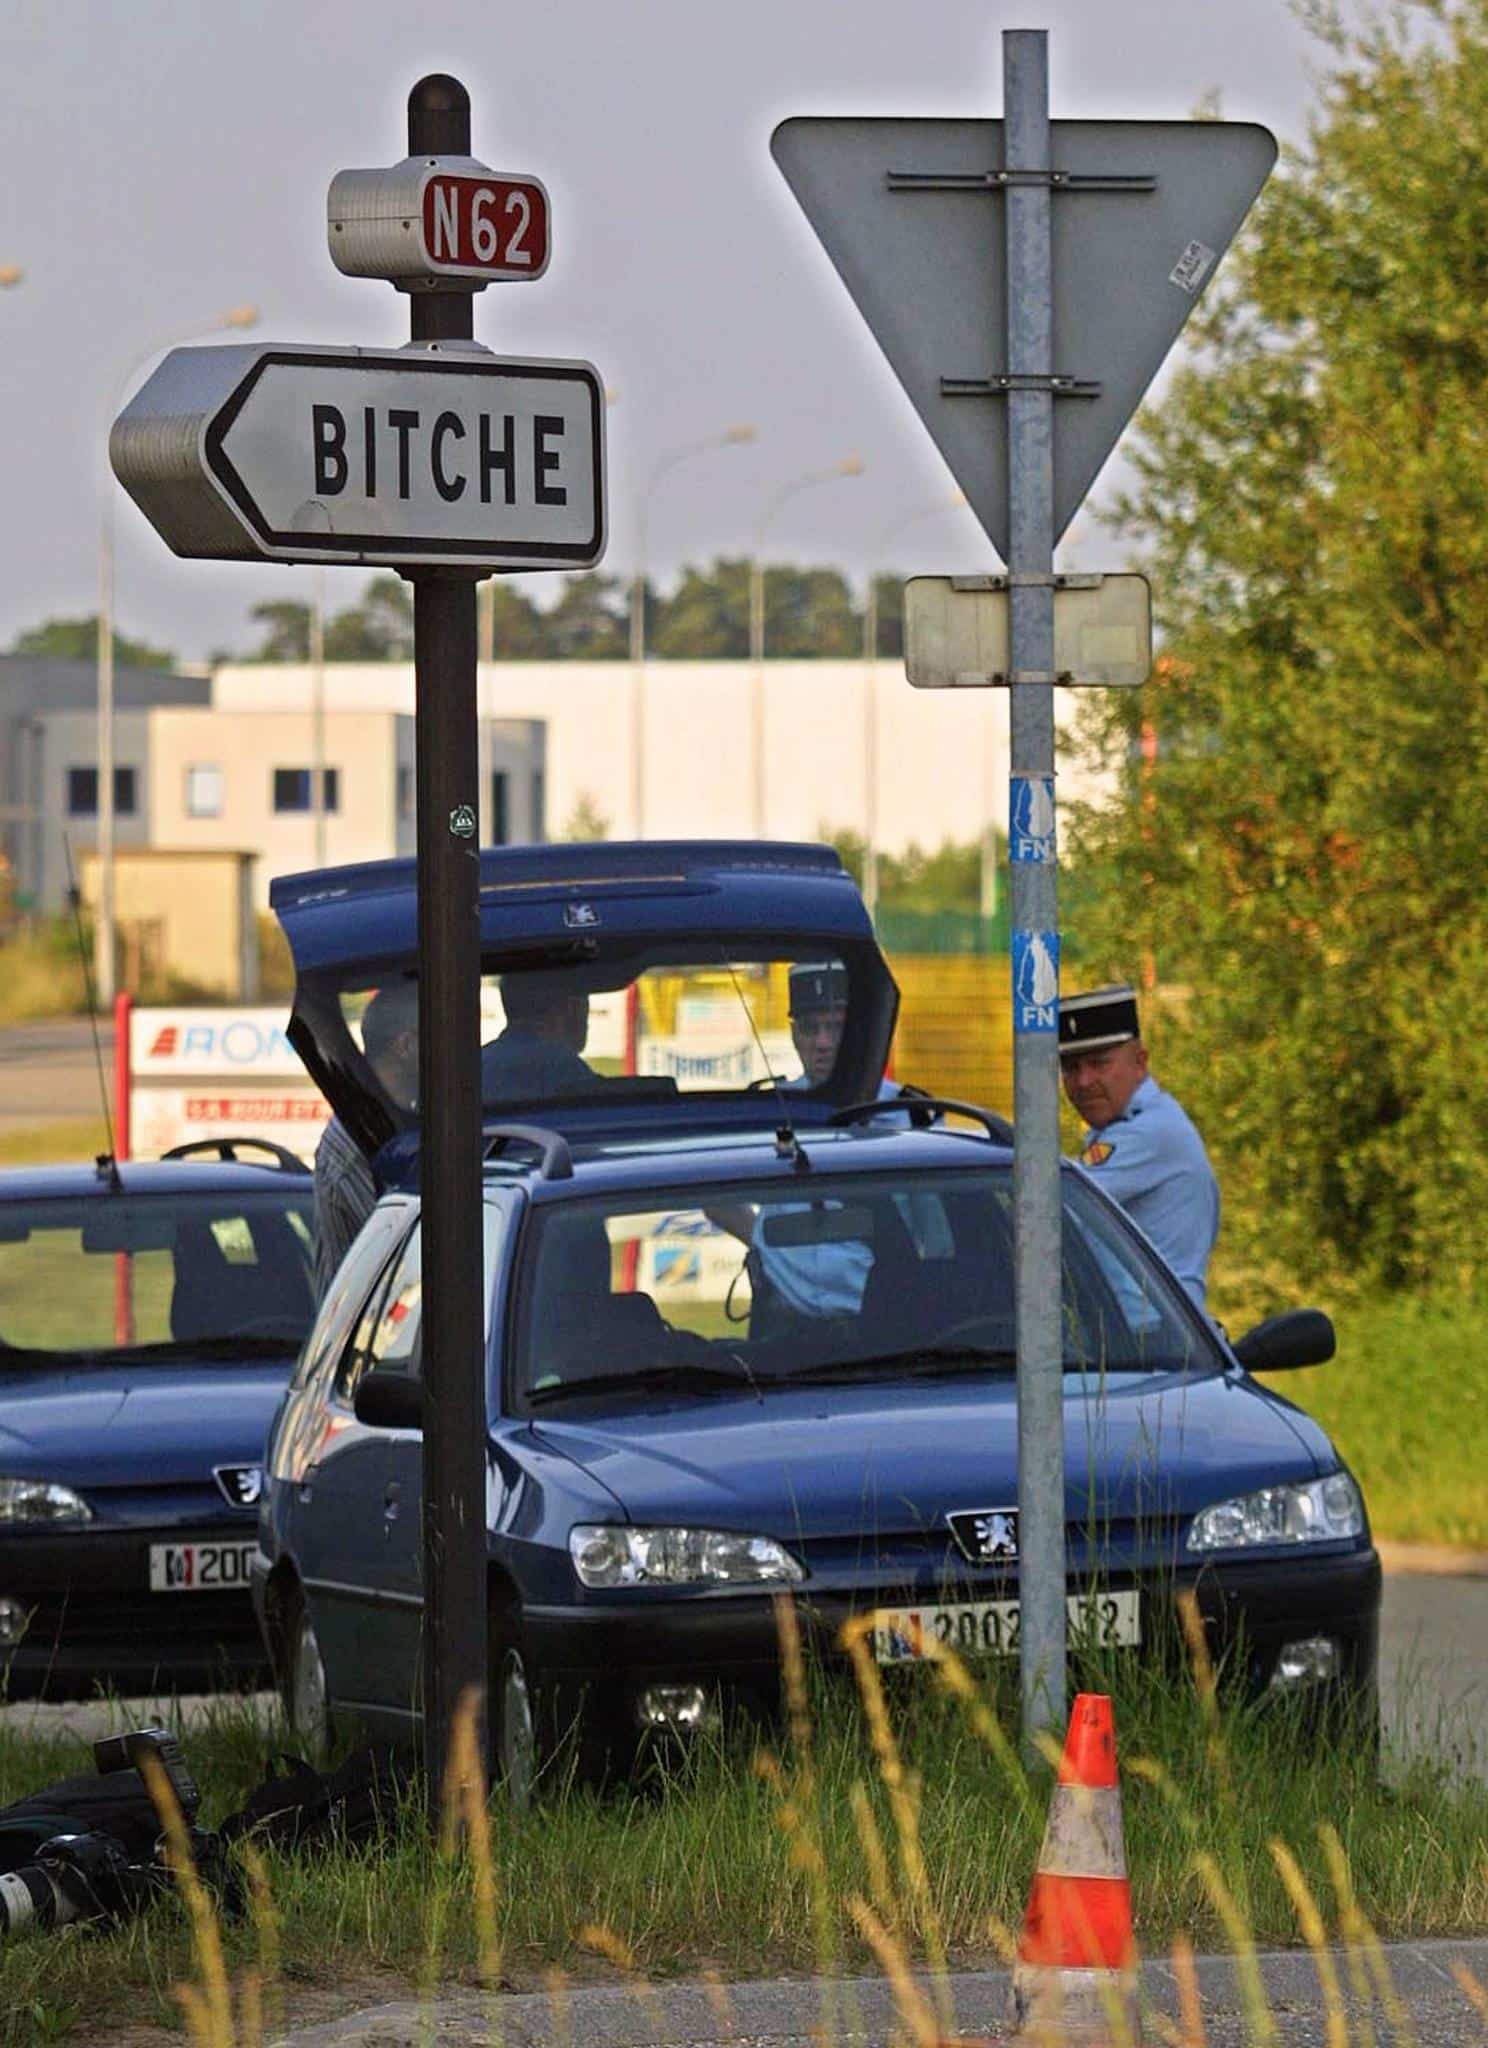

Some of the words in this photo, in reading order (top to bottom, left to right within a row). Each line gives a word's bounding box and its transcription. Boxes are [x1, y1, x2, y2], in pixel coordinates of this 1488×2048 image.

[311, 404, 568, 506] BITCHE
[1018, 839, 1050, 859] FN
[1022, 1006, 1055, 1028] FN
